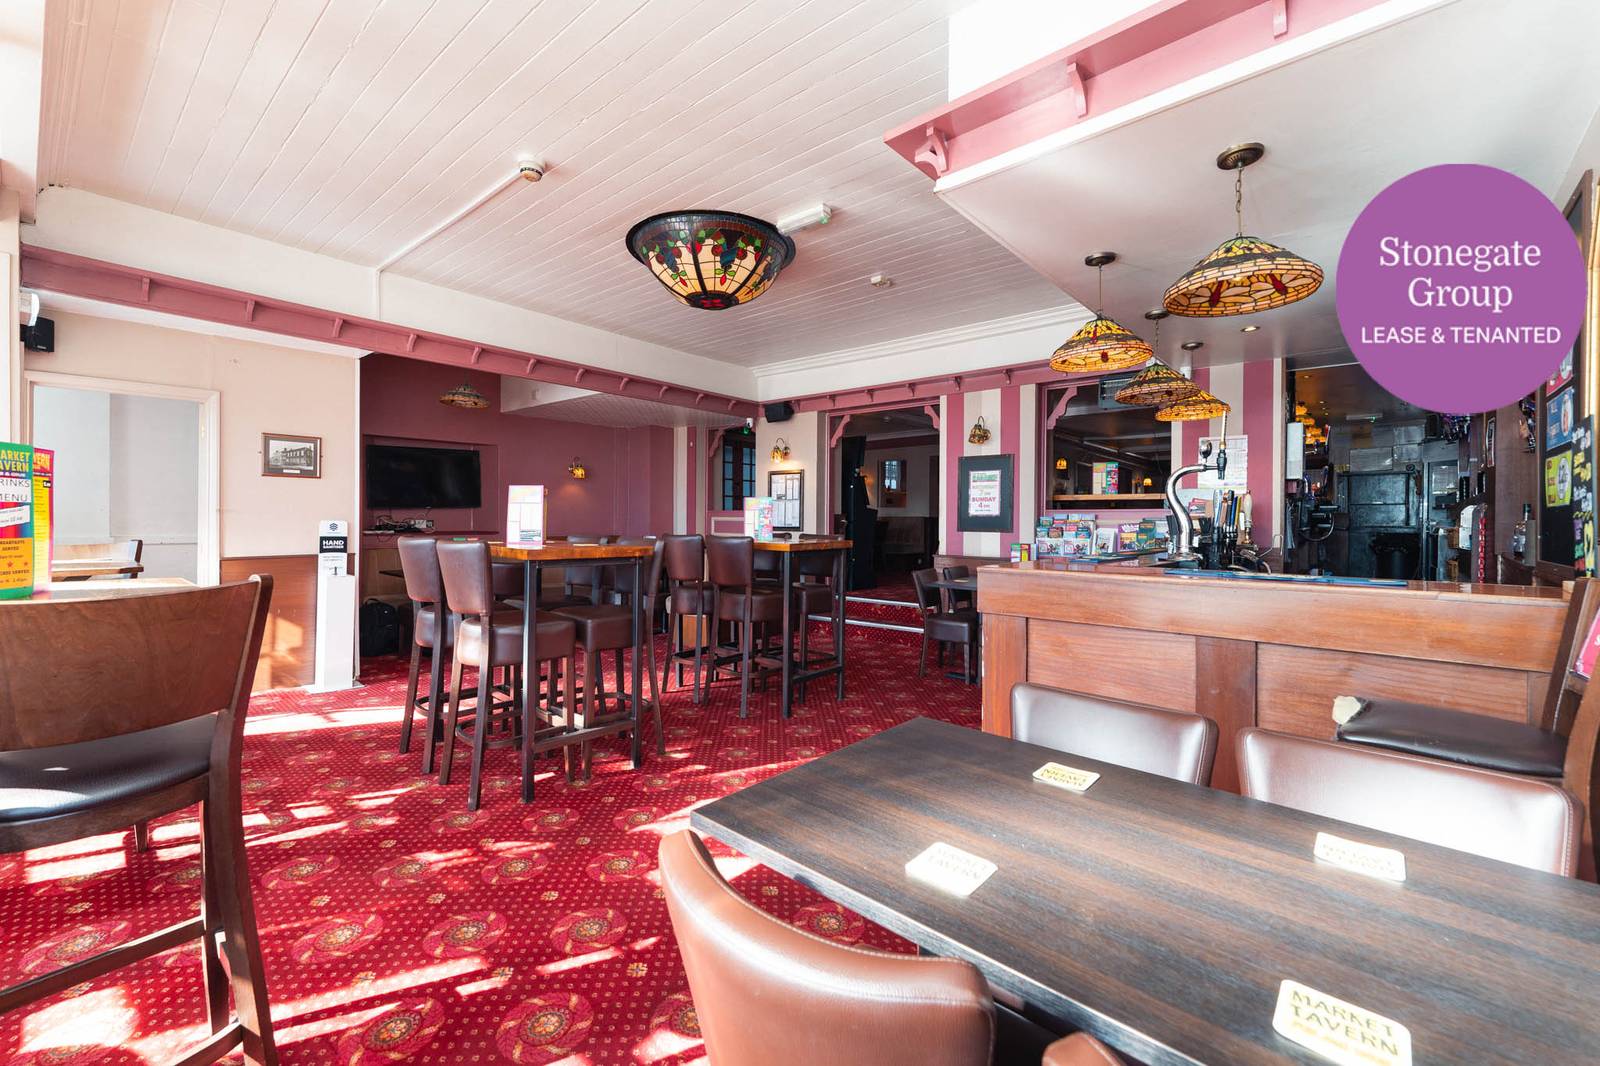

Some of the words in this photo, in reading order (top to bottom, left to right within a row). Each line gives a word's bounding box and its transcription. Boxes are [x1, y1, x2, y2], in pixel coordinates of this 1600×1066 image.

[0, 449, 30, 463] ARKET
[0, 460, 30, 473] AVERN
[0, 478, 31, 488] RINKS
[1291, 989, 1393, 1037] MARKET
[1290, 1003, 1399, 1057] TAVERN
